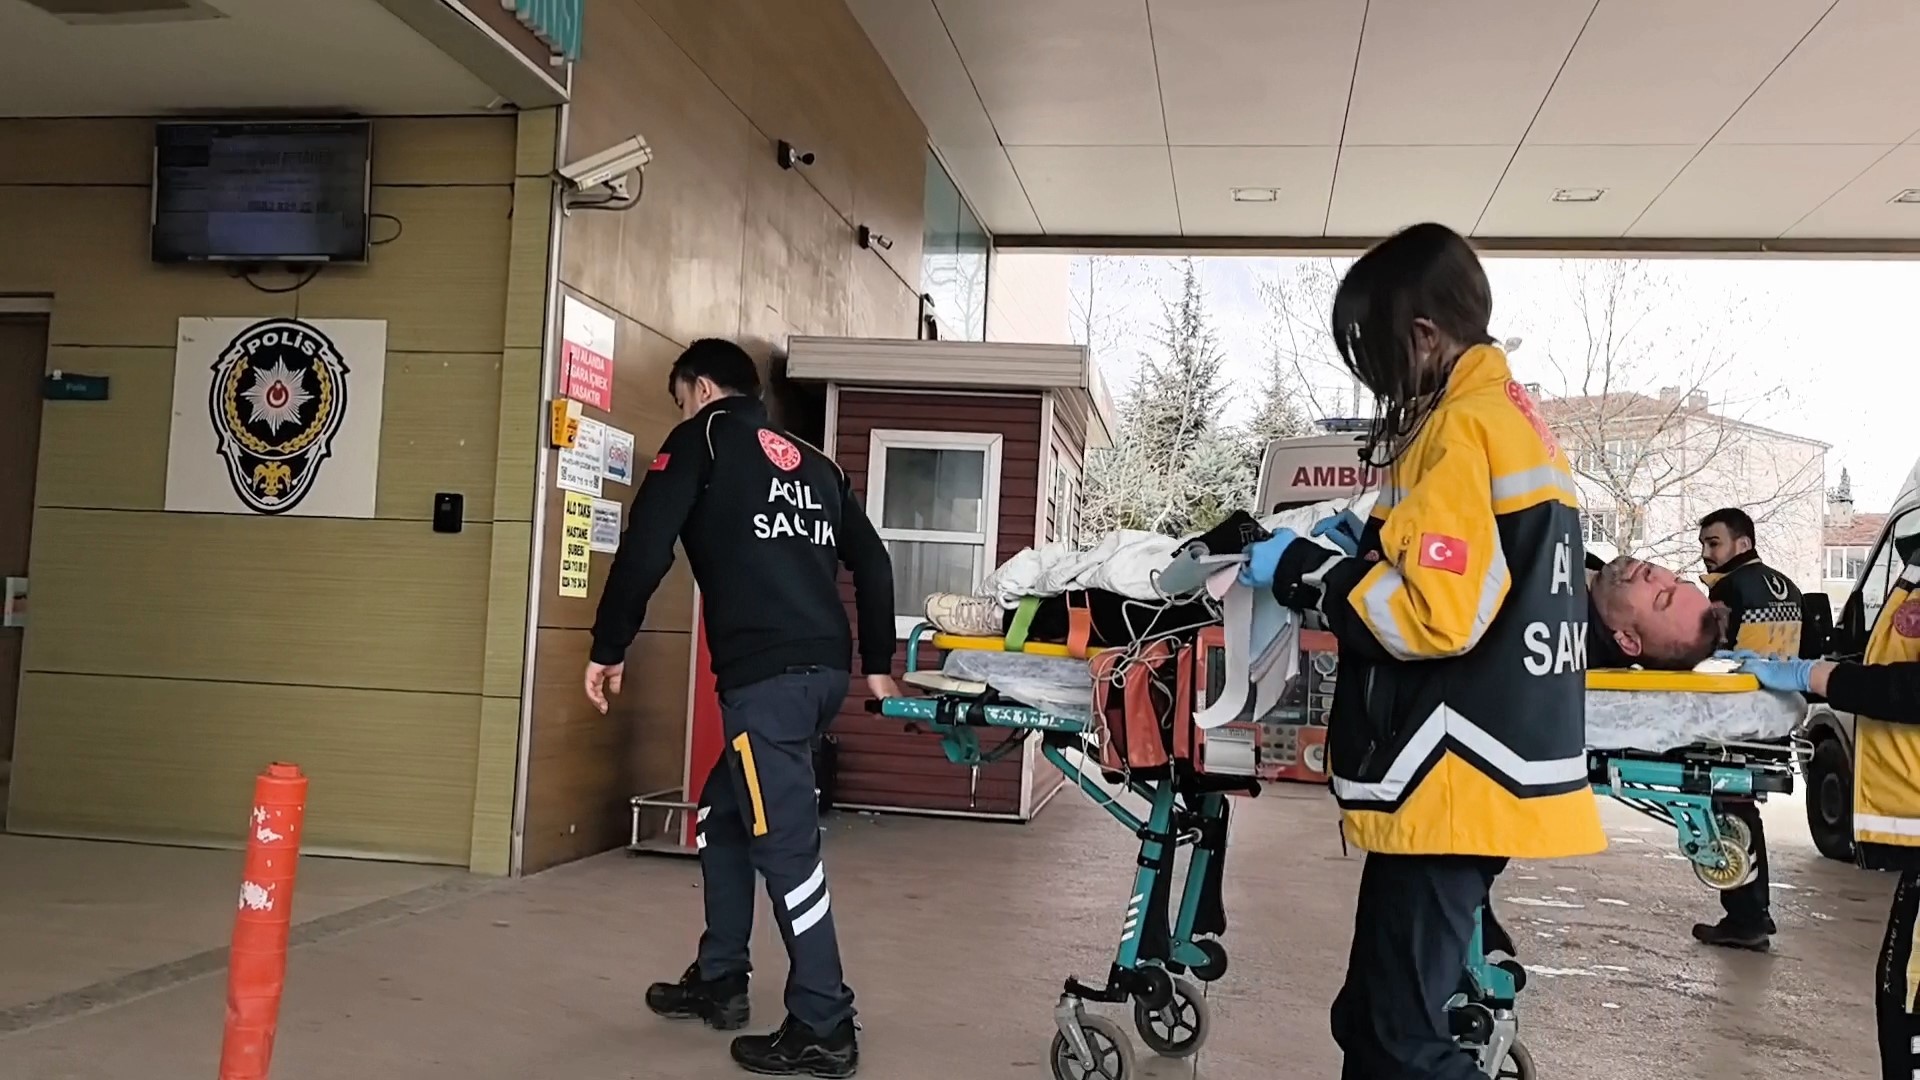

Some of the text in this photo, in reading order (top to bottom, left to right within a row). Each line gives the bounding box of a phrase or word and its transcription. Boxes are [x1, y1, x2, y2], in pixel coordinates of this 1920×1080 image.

[246, 331, 316, 356] POLİS
[565, 362, 588, 383] SGARA
[1291, 467, 1378, 487] AMBU
[566, 525, 588, 540] HASTANE
